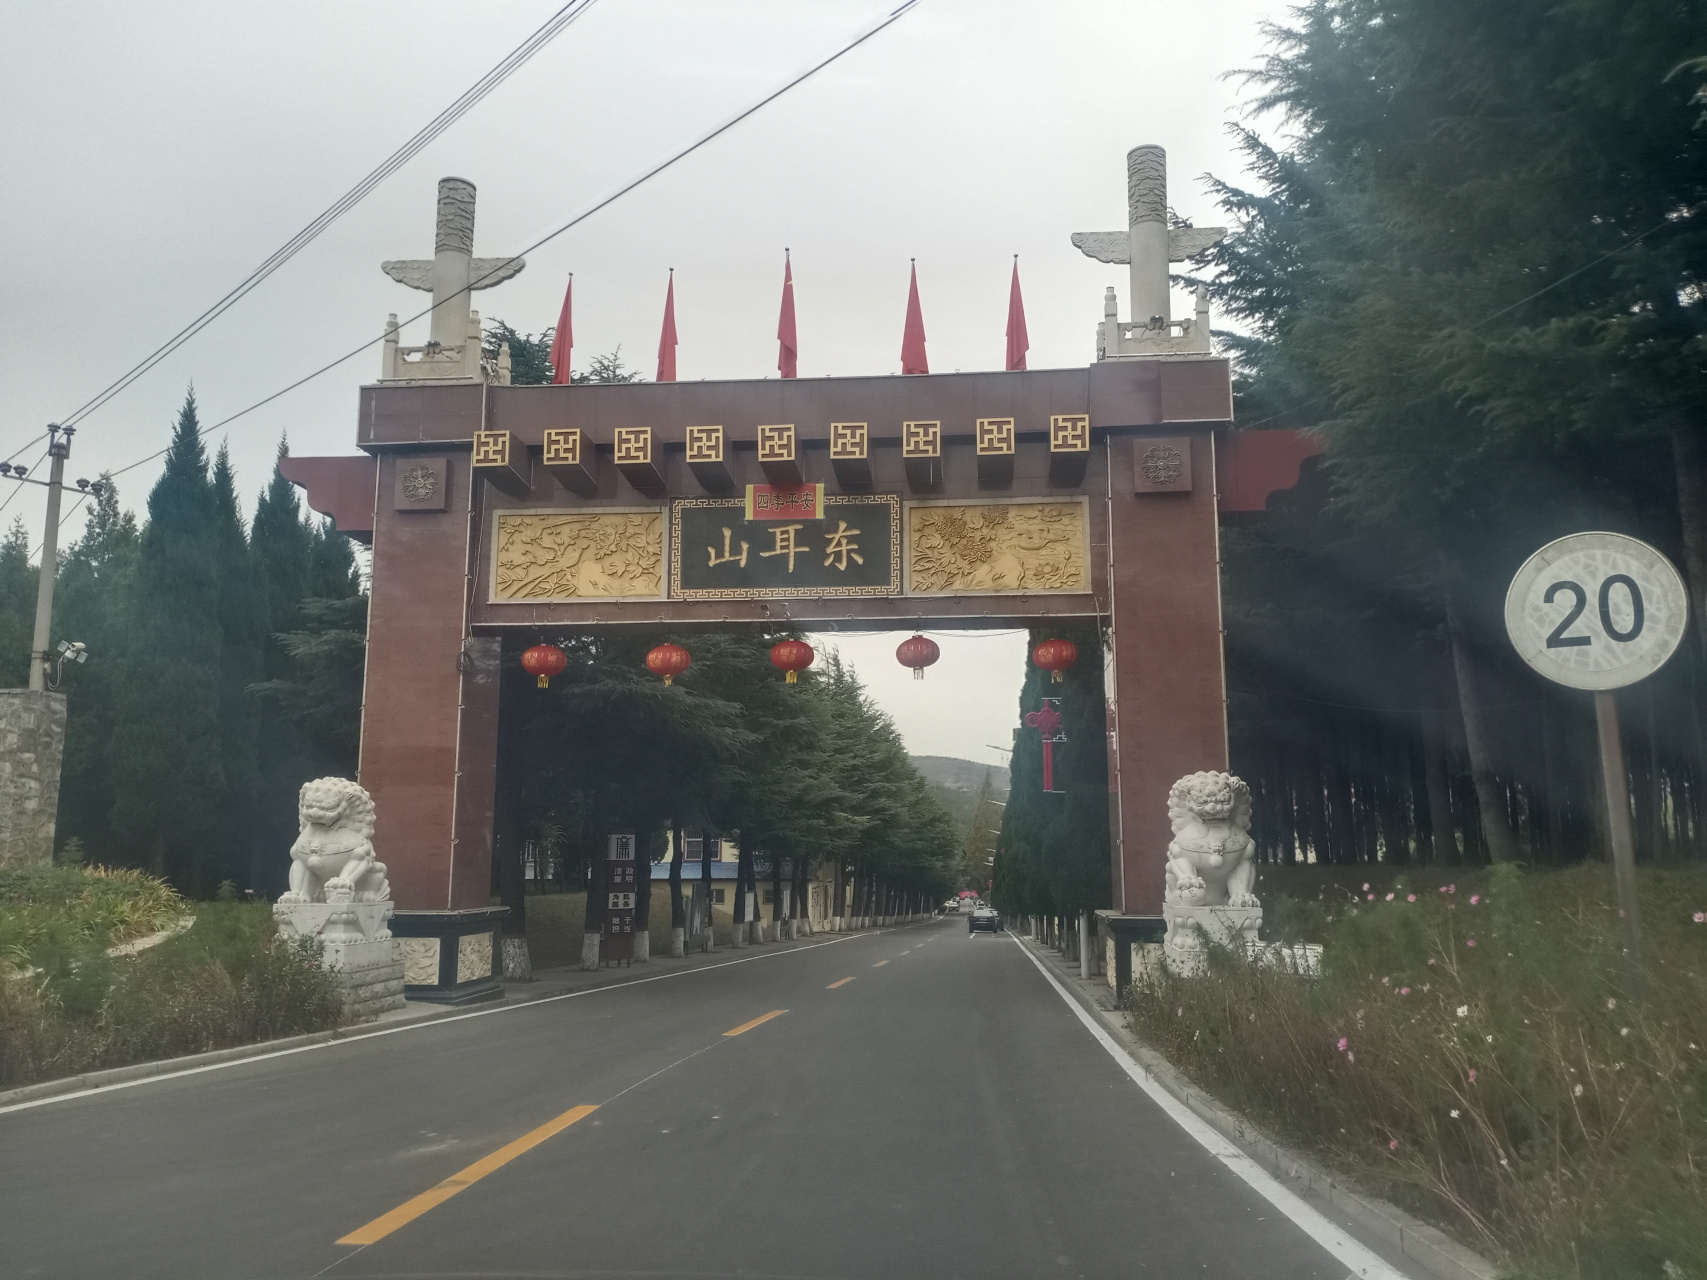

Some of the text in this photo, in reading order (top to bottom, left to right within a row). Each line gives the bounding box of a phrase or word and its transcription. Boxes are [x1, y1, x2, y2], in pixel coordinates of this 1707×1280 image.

[757, 491, 815, 511] 四季平安
[1543, 573, 1645, 649] 20
